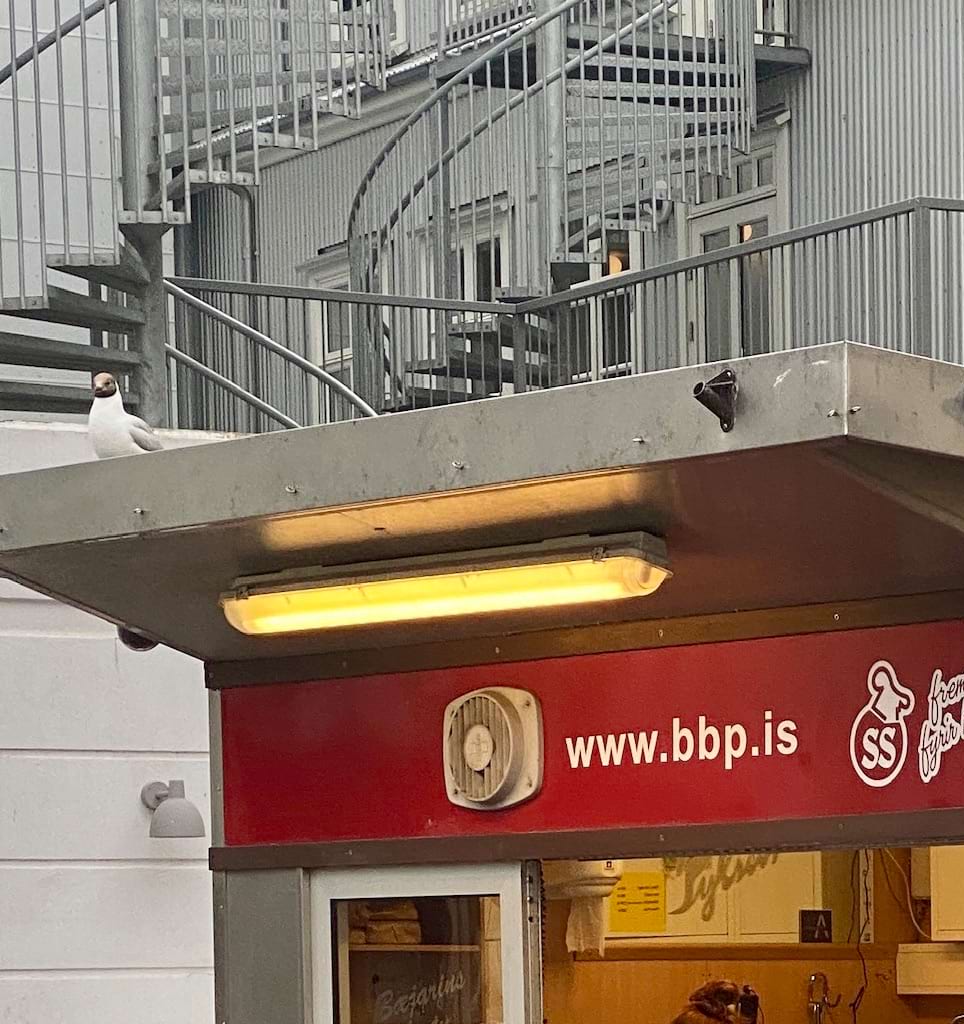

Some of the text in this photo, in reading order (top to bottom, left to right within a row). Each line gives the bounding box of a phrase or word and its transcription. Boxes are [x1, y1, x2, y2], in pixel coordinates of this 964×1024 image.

[565, 710, 799, 770] www.bbp.is
[861, 726, 897, 770] SS
[918, 713, 961, 784] fyrir
